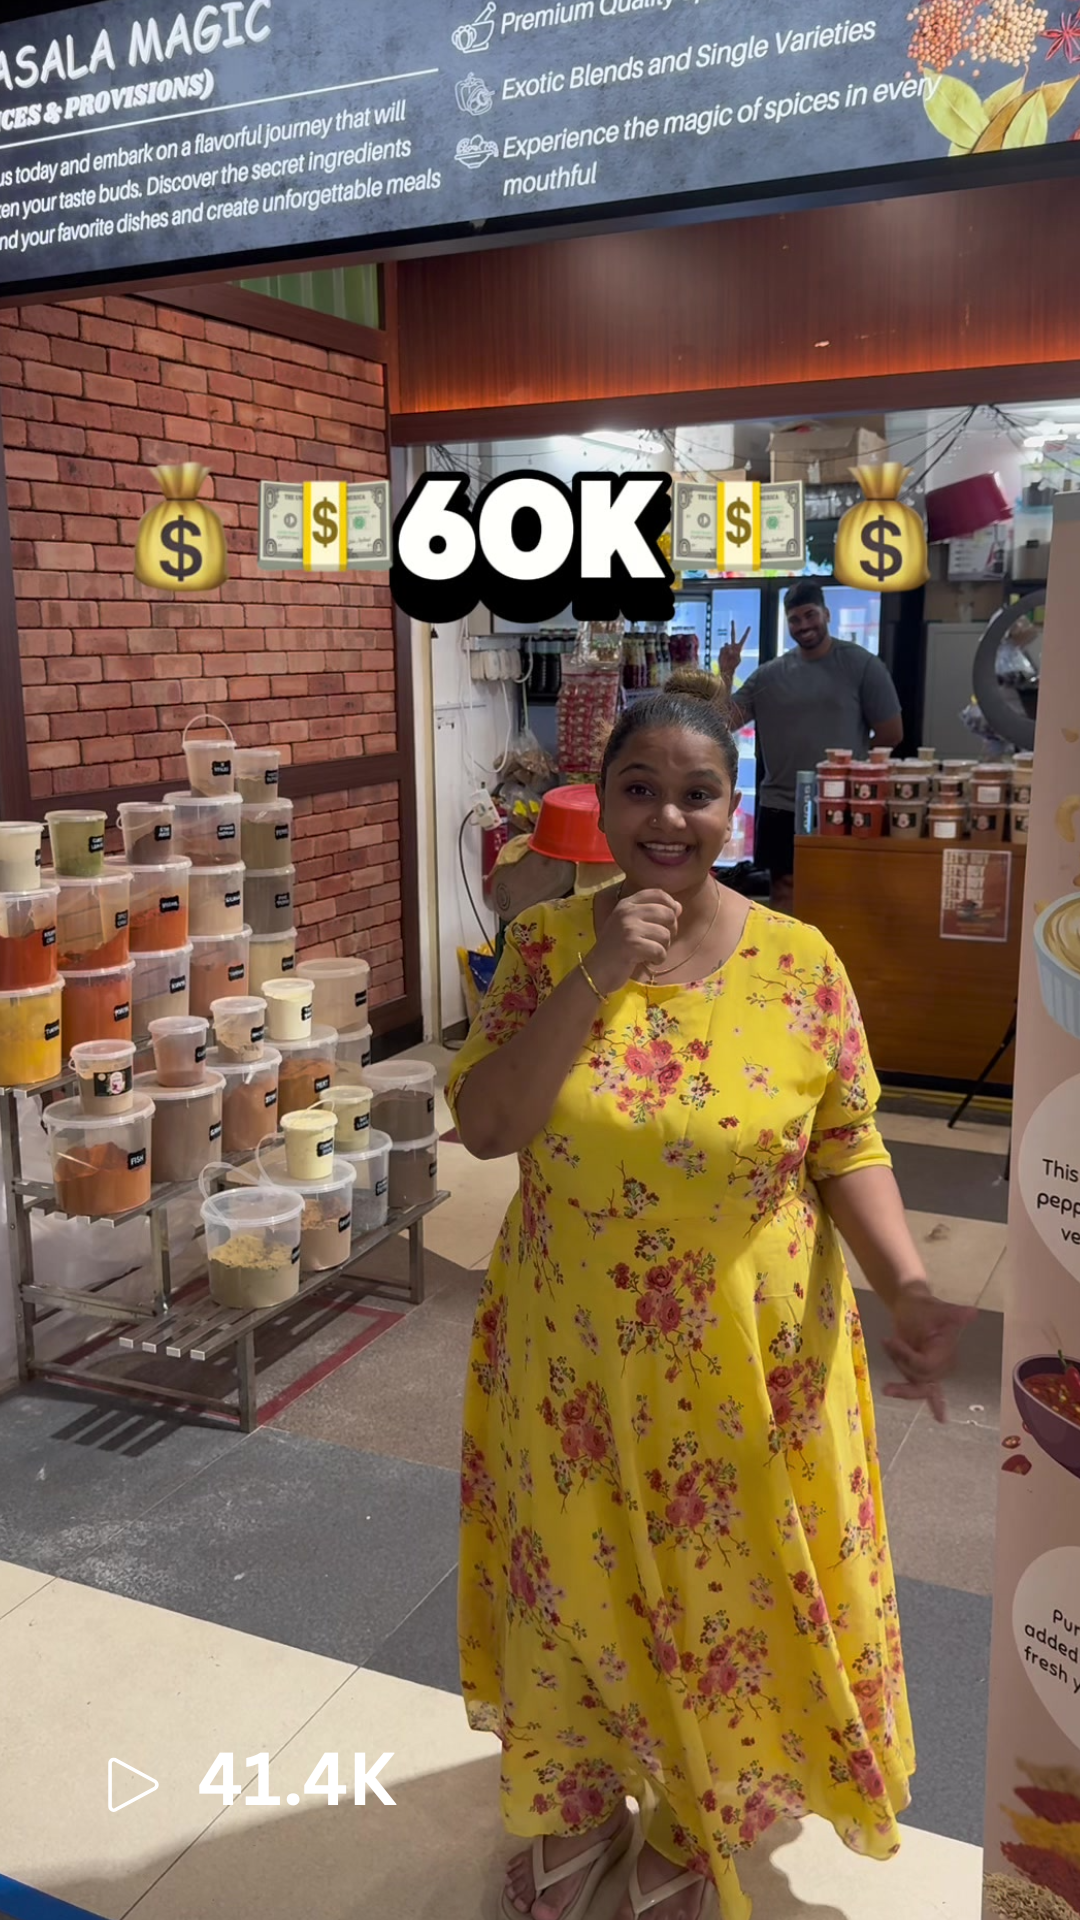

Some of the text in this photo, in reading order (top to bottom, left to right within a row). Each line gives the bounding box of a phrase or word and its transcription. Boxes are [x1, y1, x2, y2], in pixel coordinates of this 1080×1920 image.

[128, 0, 271, 68] MAGIC
[501, 1, 595, 35] Premium
[502, 19, 877, 101] Exotic Blends and Single Varieties
[0, 68, 214, 132] CES & PROVISIONS)
[503, 75, 943, 160] Experience the magic of spices in every
[15, 161, 58, 184] today
[60, 153, 91, 177] and
[93, 143, 154, 170] embark
[156, 140, 178, 160] on
[181, 140, 191, 157] a
[195, 124, 262, 154] flavorful
[263, 116, 333, 149] journey
[335, 108, 371, 131] that
[374, 99, 407, 125] will
[0, 138, 412, 220] en your taste buds. Discover the secret ingredients
[20, 228, 57, 252] your
[57, 219, 114, 243] favorite
[116, 211, 169, 232] dishes
[171, 202, 204, 226] and
[206, 198, 259, 220] create
[262, 177, 382, 212] unforgettable
[386, 168, 442, 195] meals
[503, 161, 598, 196] mouthful
[130, 1154, 144, 1166] FISH
[1042, 1158, 1079, 1183] This
[1024, 1624, 1079, 1664] added
[1024, 1645, 1068, 1684] fresh
